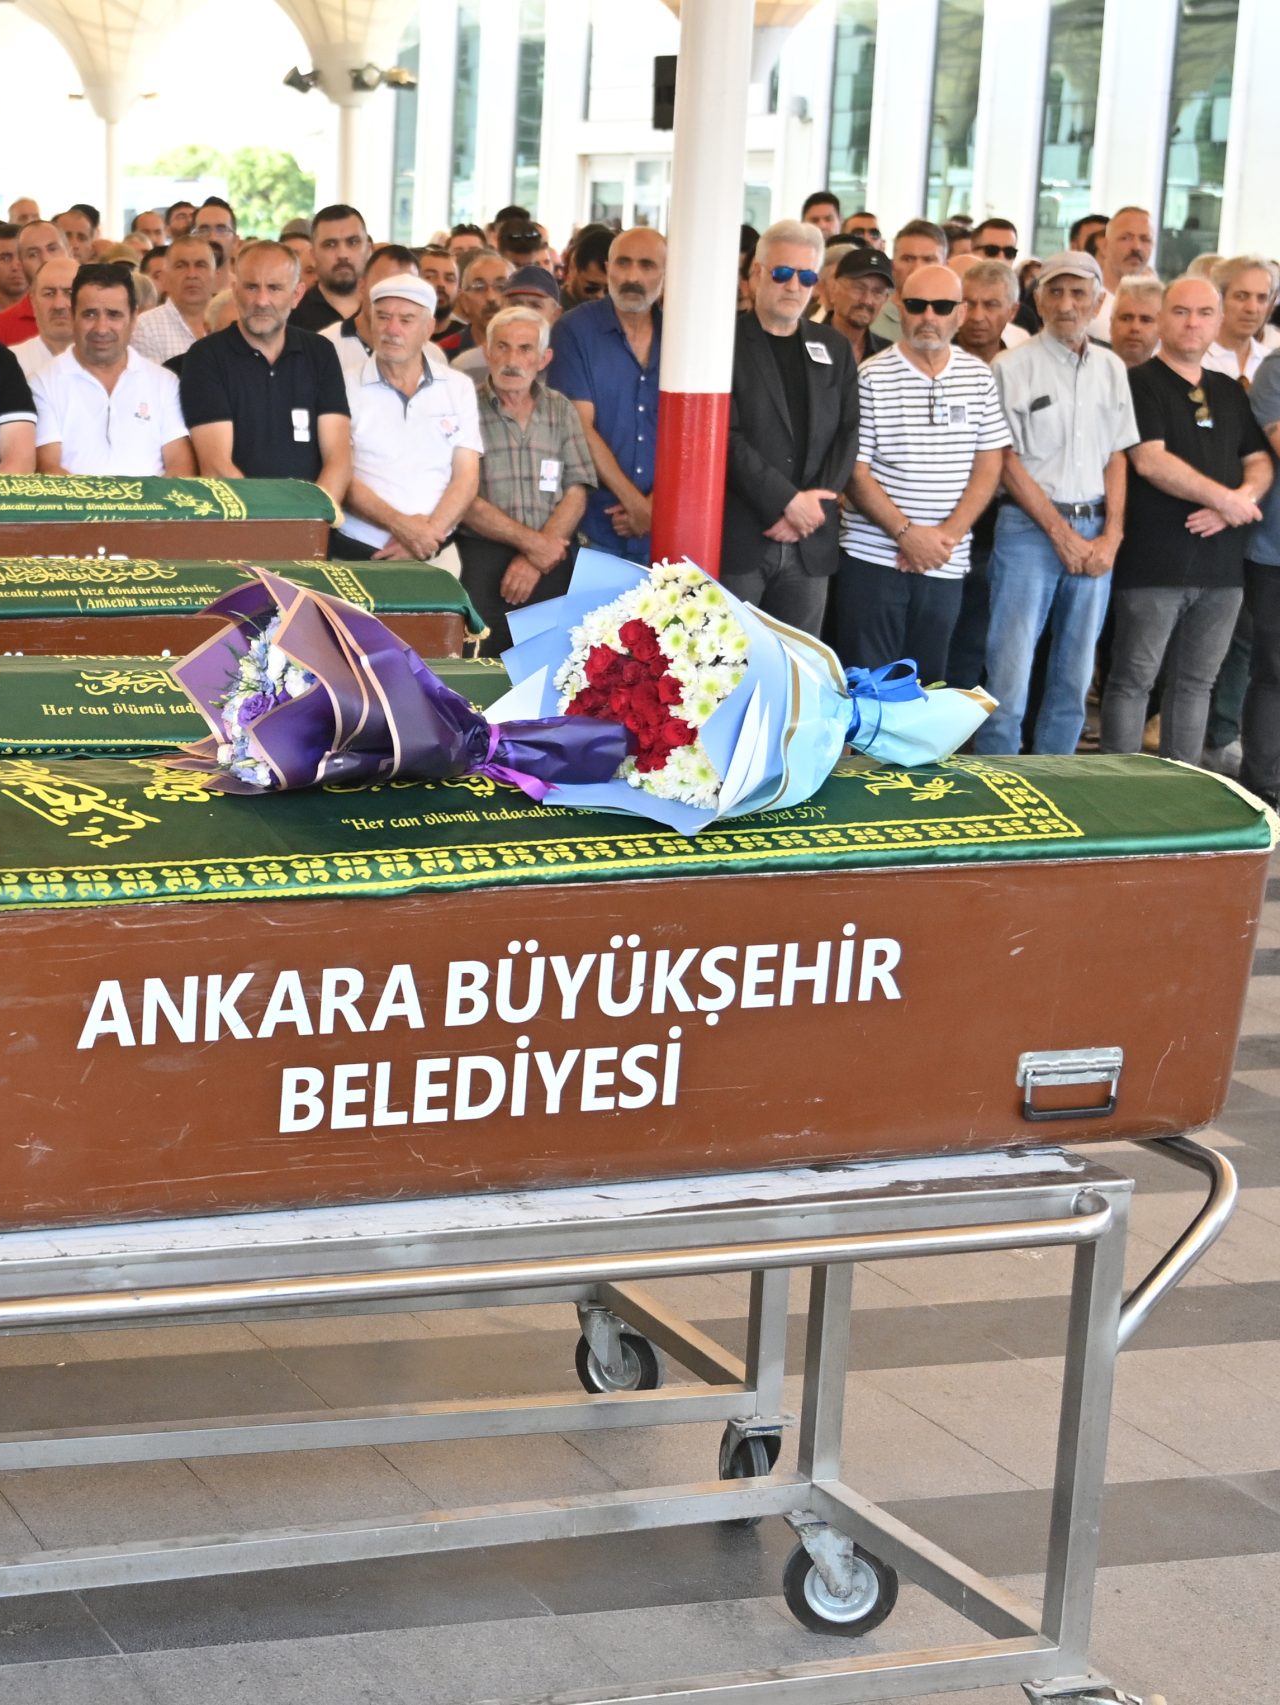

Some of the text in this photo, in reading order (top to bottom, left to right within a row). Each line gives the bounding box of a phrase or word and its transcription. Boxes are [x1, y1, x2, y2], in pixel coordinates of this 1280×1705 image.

[79, 587, 105, 596] bize
[41, 703, 73, 716] Her
[79, 705, 109, 716] can
[113, 702, 167, 716] ölümü
[390, 816, 421, 828] can
[423, 809, 480, 826] ölümü
[760, 808, 795, 824] Ayet
[77, 923, 902, 1050] ANKARA BÜYÜKŞEHİR
[279, 1025, 681, 1132] BELEDİYESİ
